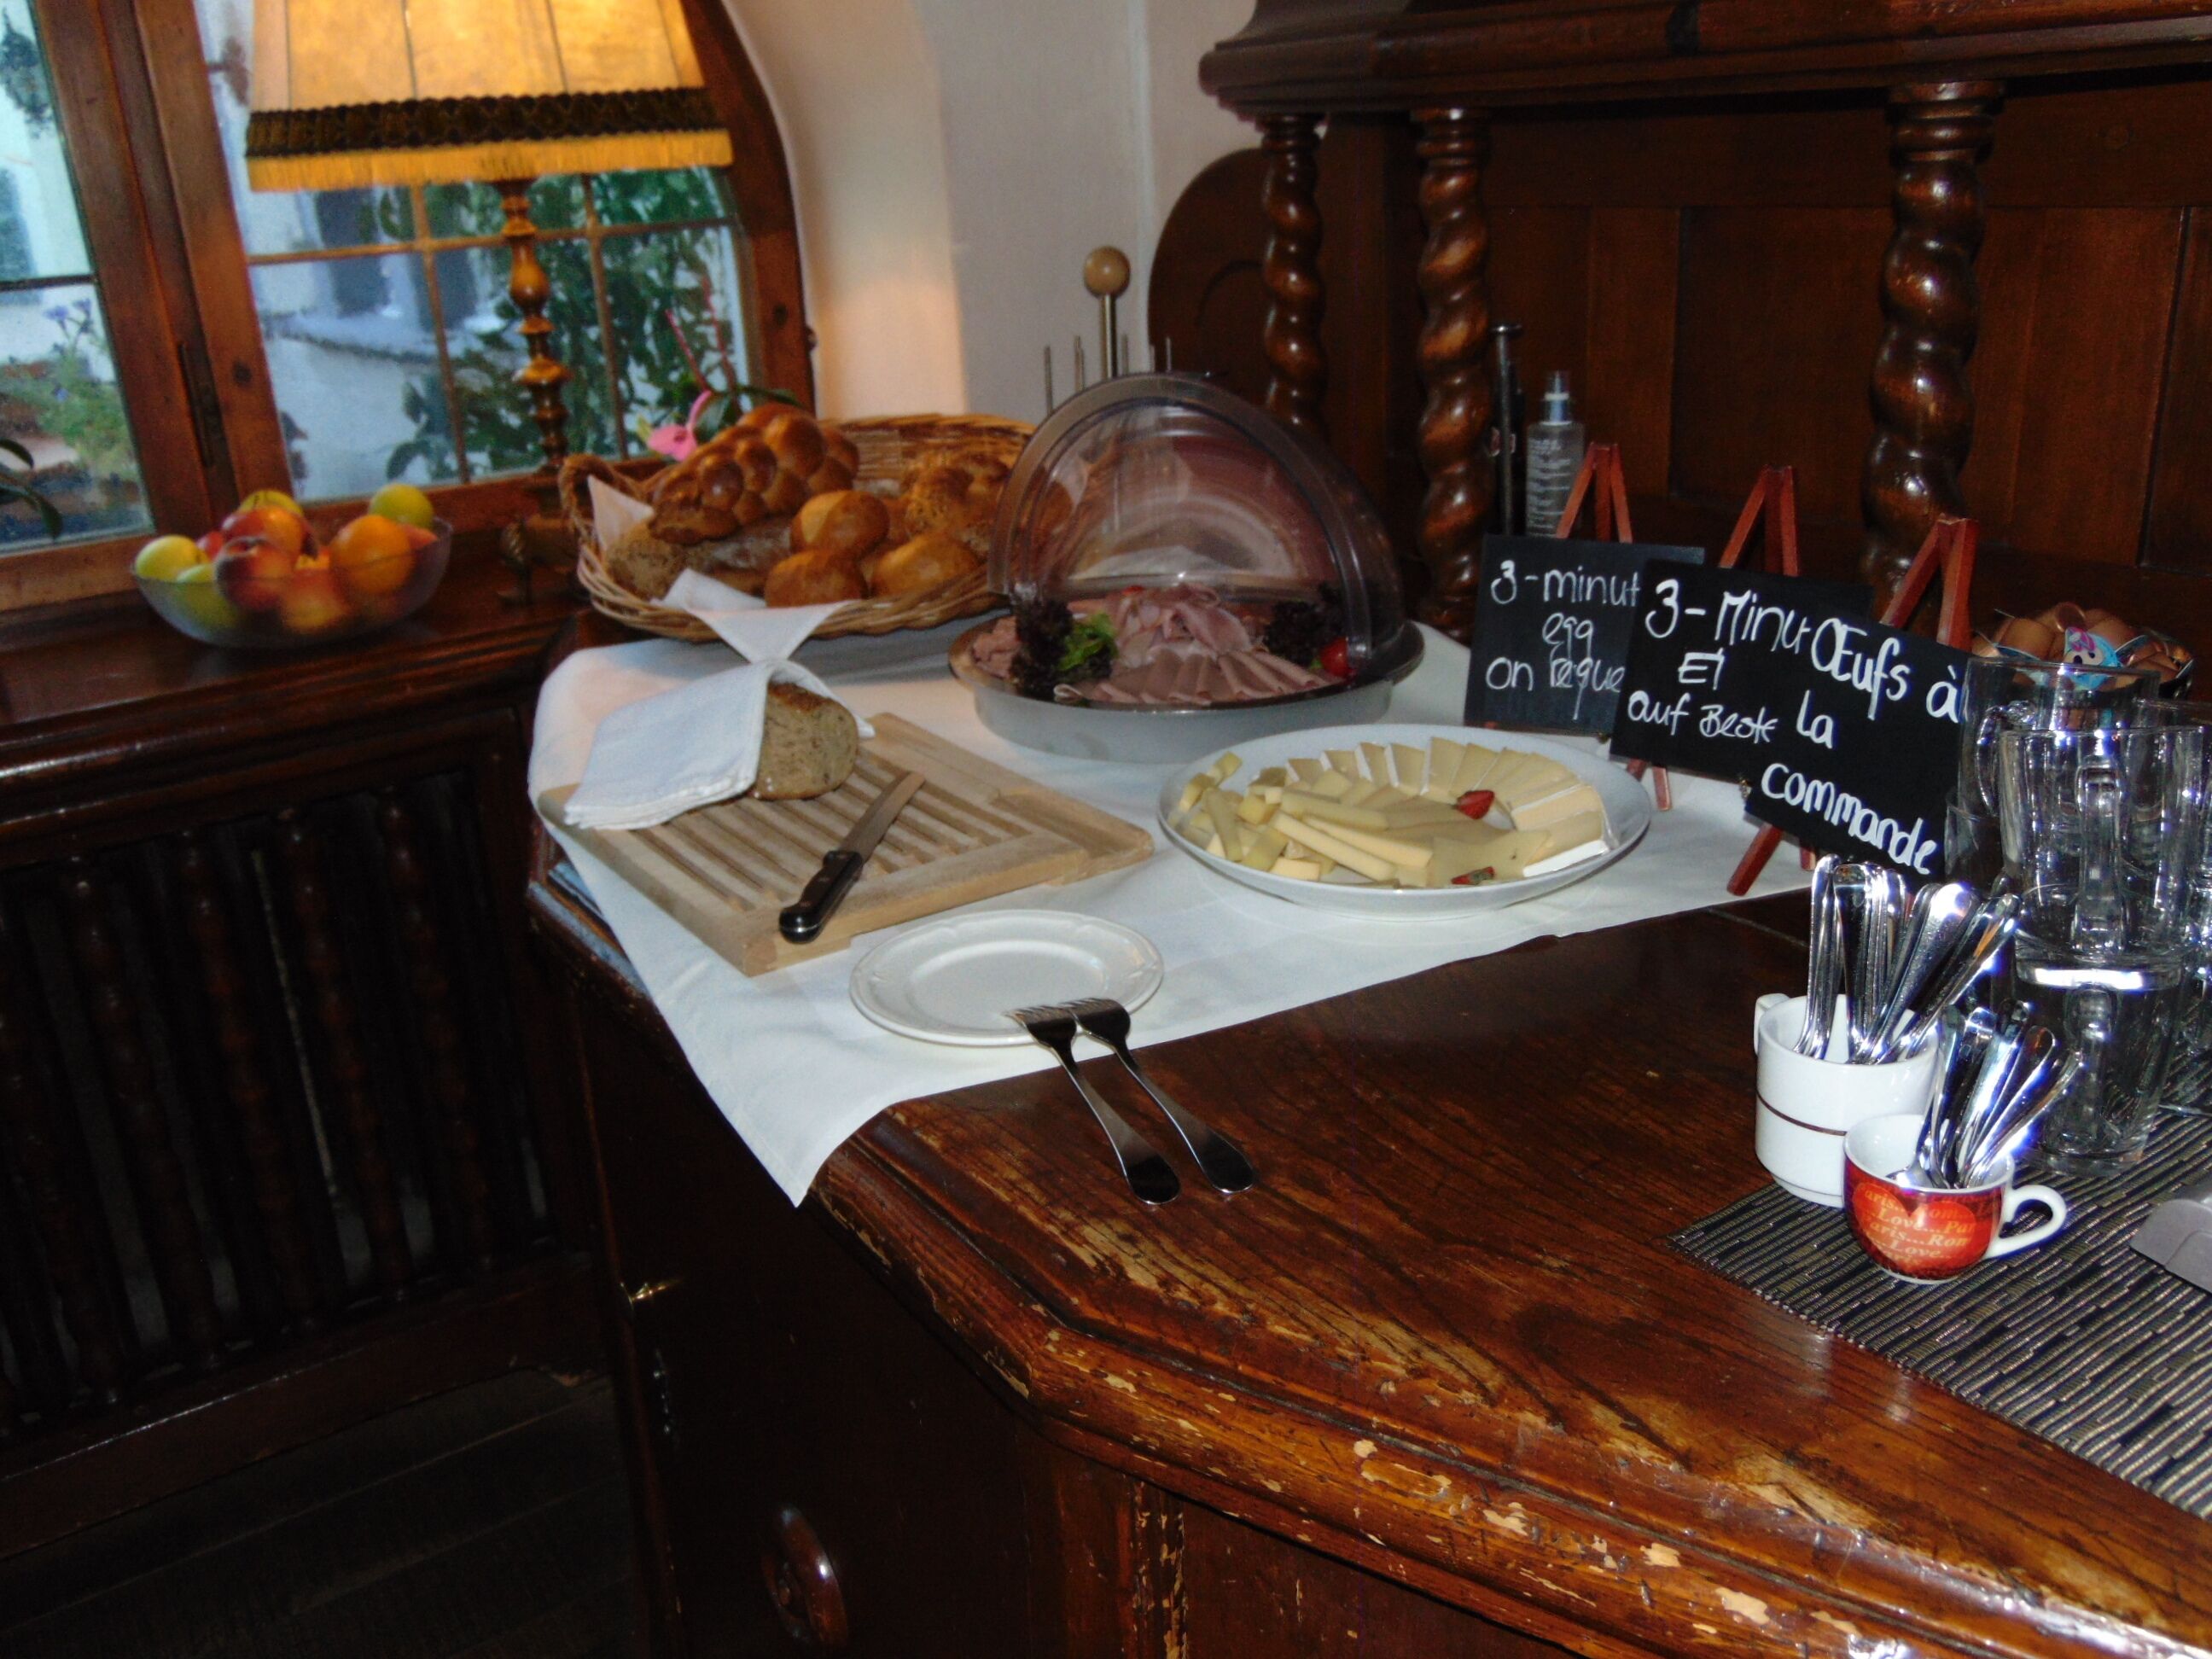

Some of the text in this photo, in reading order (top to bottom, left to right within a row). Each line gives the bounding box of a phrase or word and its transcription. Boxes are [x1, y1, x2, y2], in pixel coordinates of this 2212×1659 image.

[1491, 560, 1640, 606] 3-minut
[1542, 612, 1594, 660] egg
[1550, 656, 1625, 720] reque
[1627, 690, 1691, 736] auf
[1796, 690, 1833, 748] la
